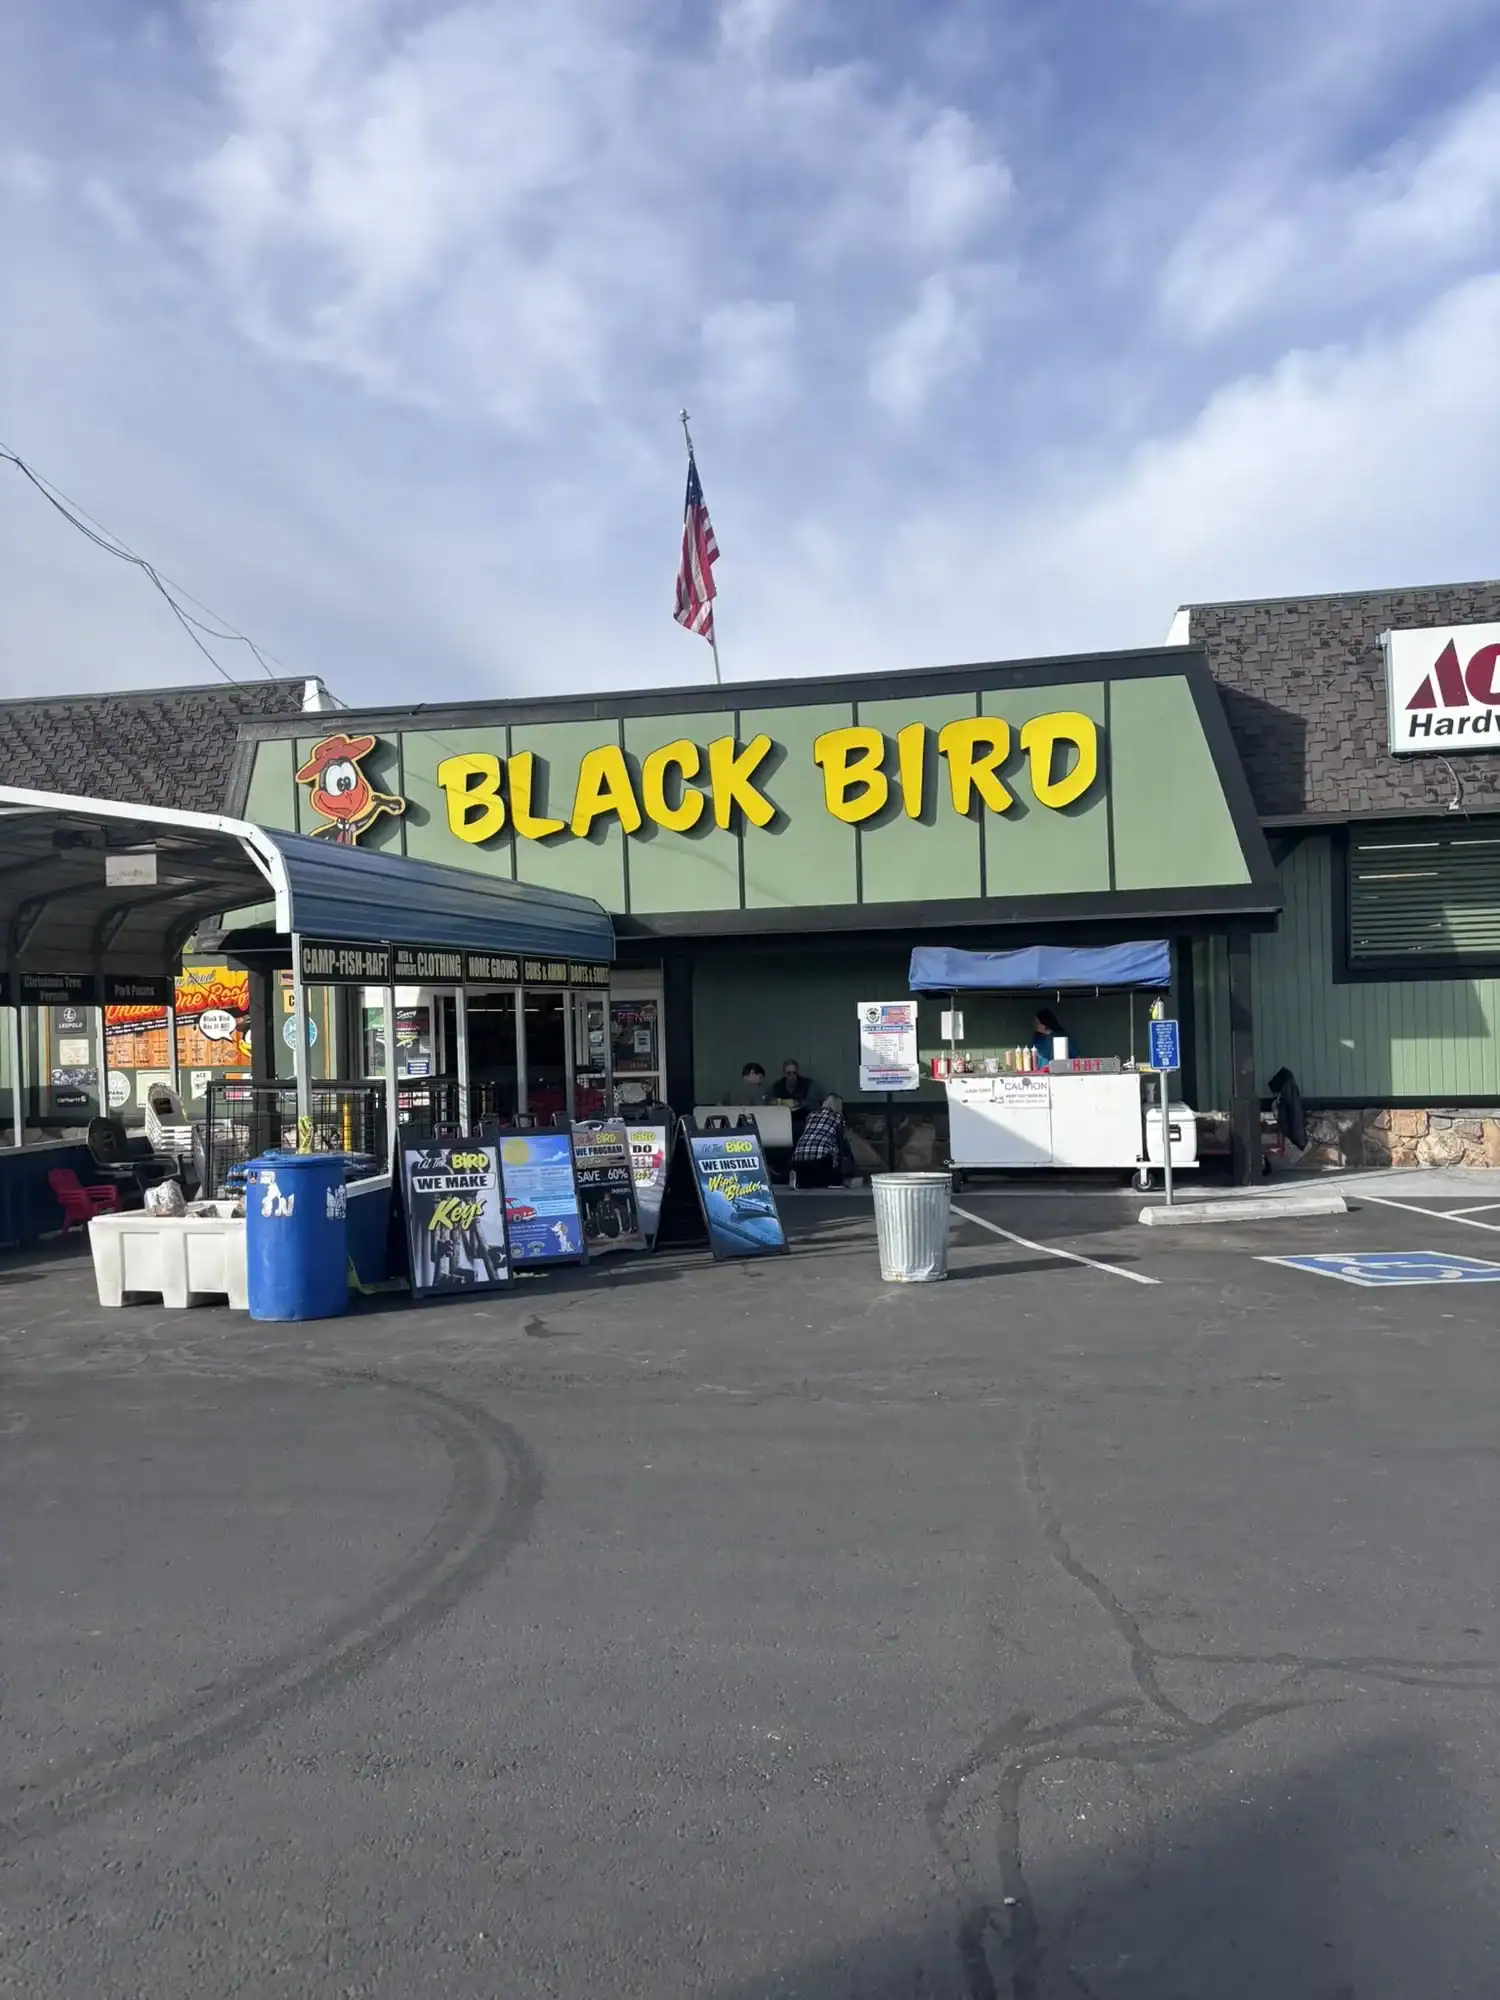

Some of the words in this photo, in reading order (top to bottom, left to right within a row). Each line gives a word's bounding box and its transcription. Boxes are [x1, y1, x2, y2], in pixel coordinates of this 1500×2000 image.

[1408, 709, 1500, 737] Hard
[437, 733, 776, 844] BLACK
[813, 711, 1097, 823] BIRD
[303, 947, 388, 976] CAMP-FISH-RAFT
[417, 952, 461, 976] CLOTHING
[468, 957, 490, 977] HOME
[491, 958, 518, 979] GROWS
[525, 960, 541, 980] GUNS
[542, 965, 547, 980] &
[208, 979, 249, 1011] Roof
[576, 1147, 588, 1156] WE
[589, 1145, 622, 1155] PROGRAM
[632, 1156, 653, 1168] EEN
[576, 1170, 601, 1183] SAVE
[607, 1168, 628, 1180] 60%
[702, 1160, 719, 1171] WE
[720, 1158, 758, 1170] INSTALL
[417, 1178, 442, 1190] WE
[445, 1175, 488, 1189] MAKE
[708, 1173, 738, 1192] Wiper
[724, 1181, 761, 1202] Blades
[428, 1197, 487, 1231] Keys
